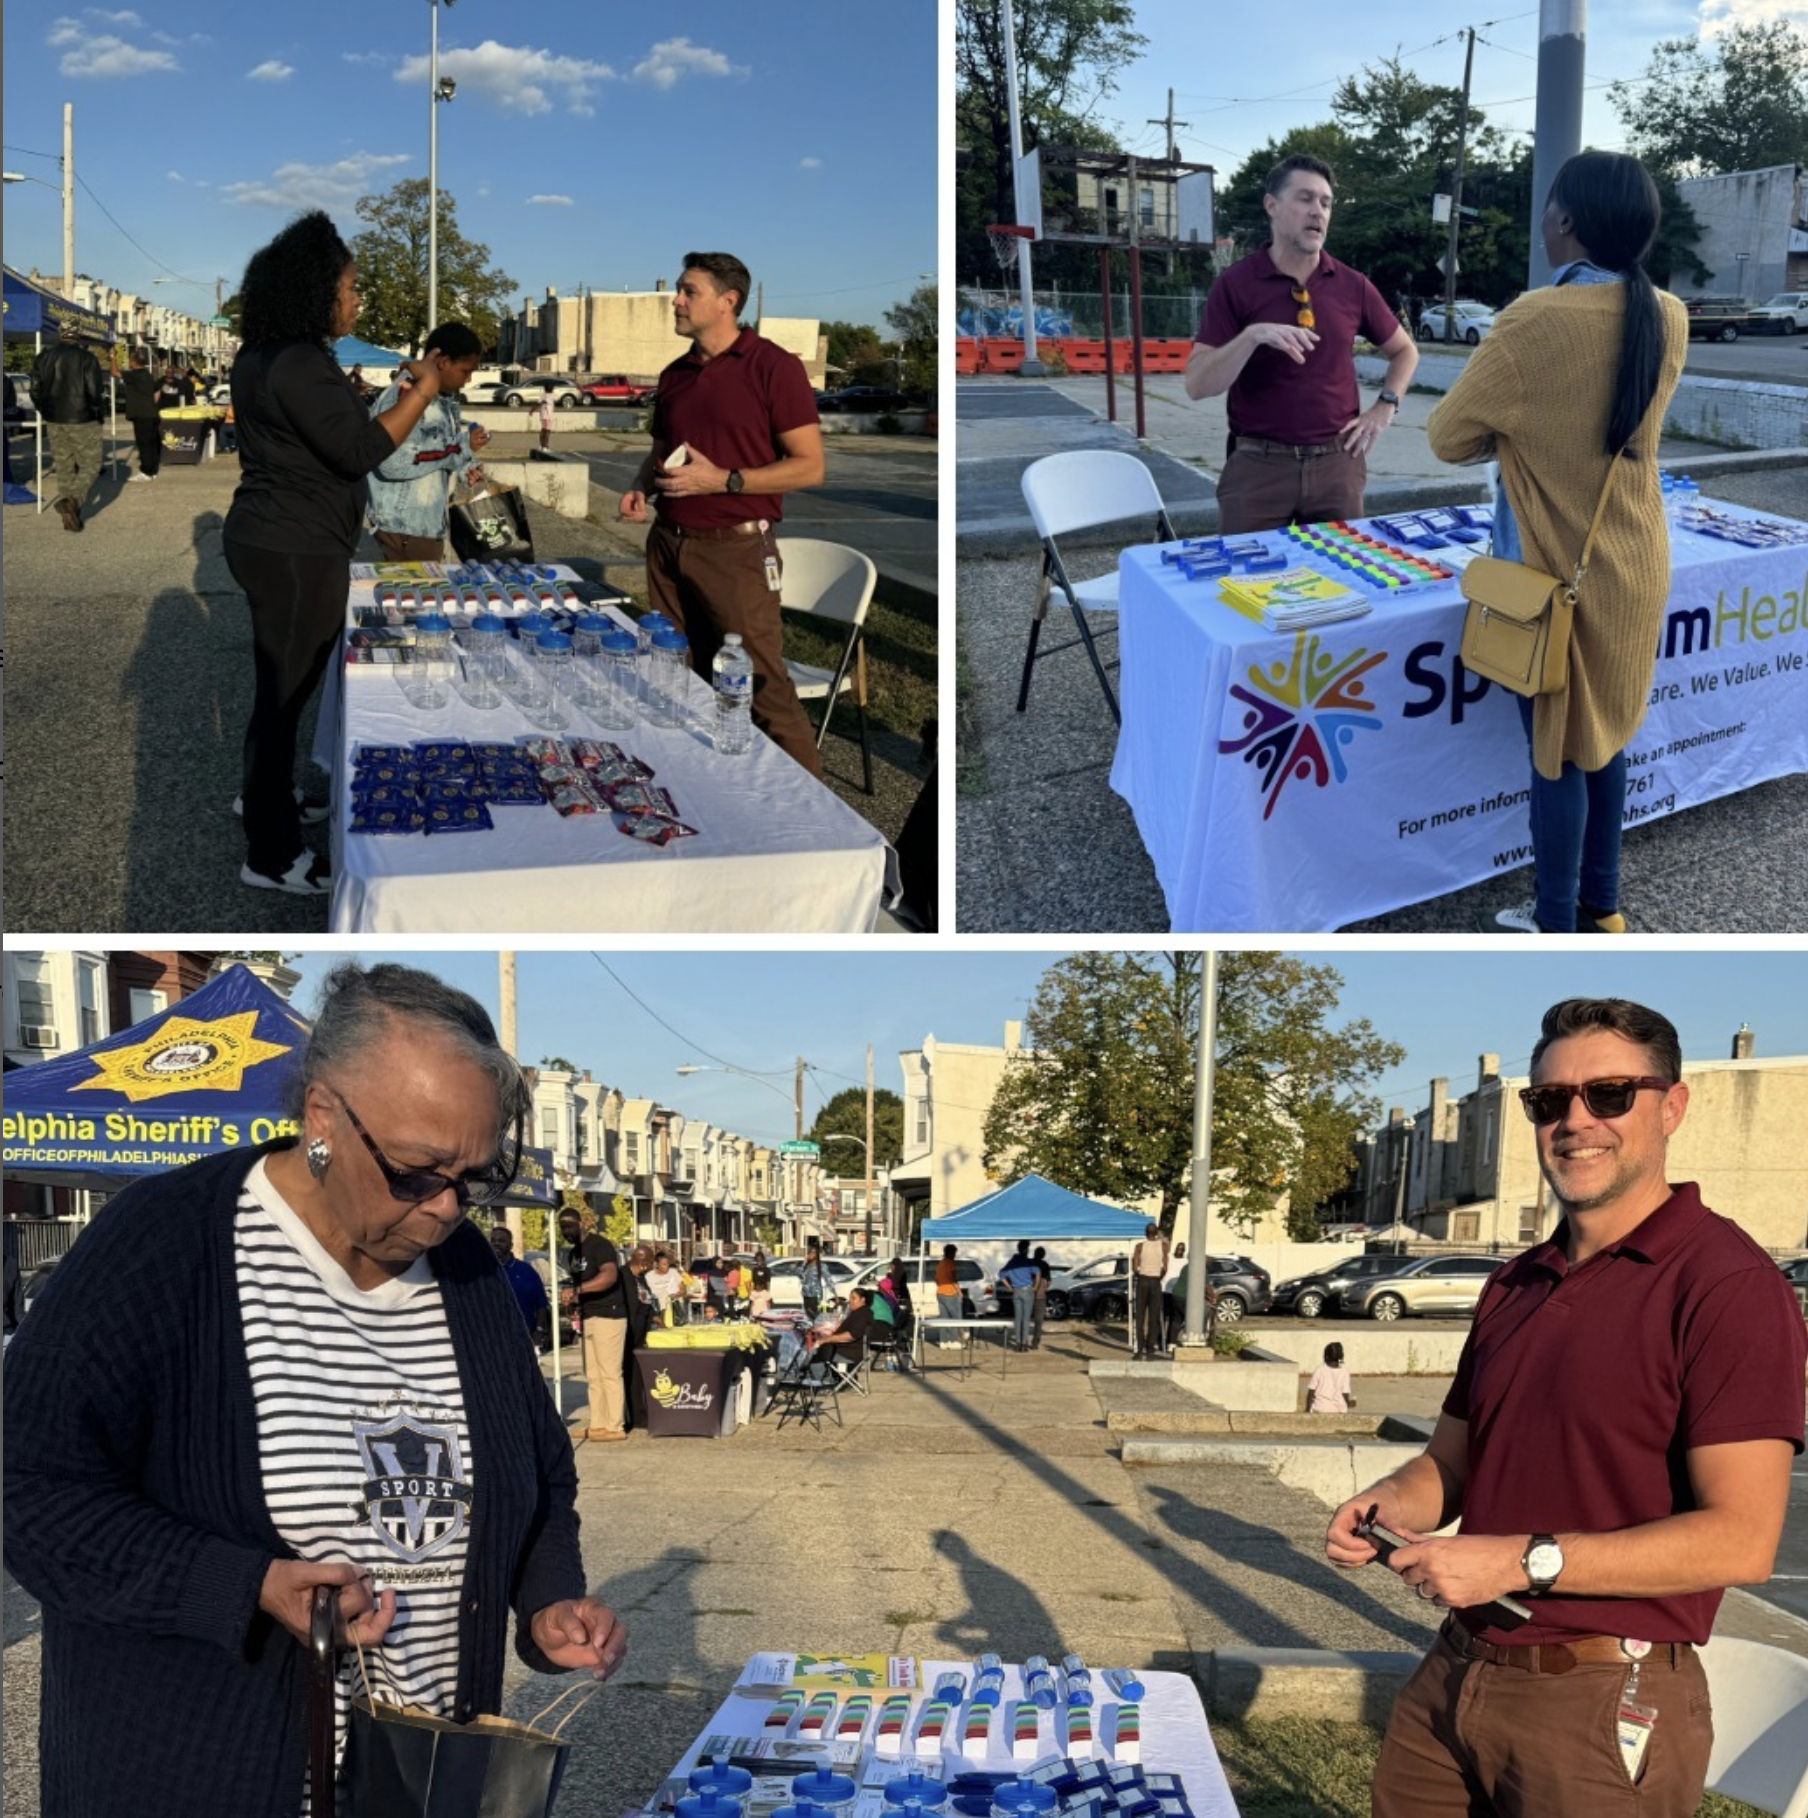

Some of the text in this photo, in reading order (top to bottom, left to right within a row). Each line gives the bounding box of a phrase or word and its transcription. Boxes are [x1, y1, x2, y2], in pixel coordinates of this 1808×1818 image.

[1691, 672, 1719, 695] We
[1723, 662, 1772, 688] Value.
[1776, 651, 1803, 673] We
[1398, 817, 1427, 839] For
[1431, 804, 1476, 828] more
[1651, 746, 1664, 761] an
[1667, 722, 1747, 756] appointment:
[3, 1112, 95, 1146] elphia
[105, 1114, 240, 1146] Sheriff's
[674, 1382, 714, 1411] Baby
[380, 1478, 453, 1497] SPORT
